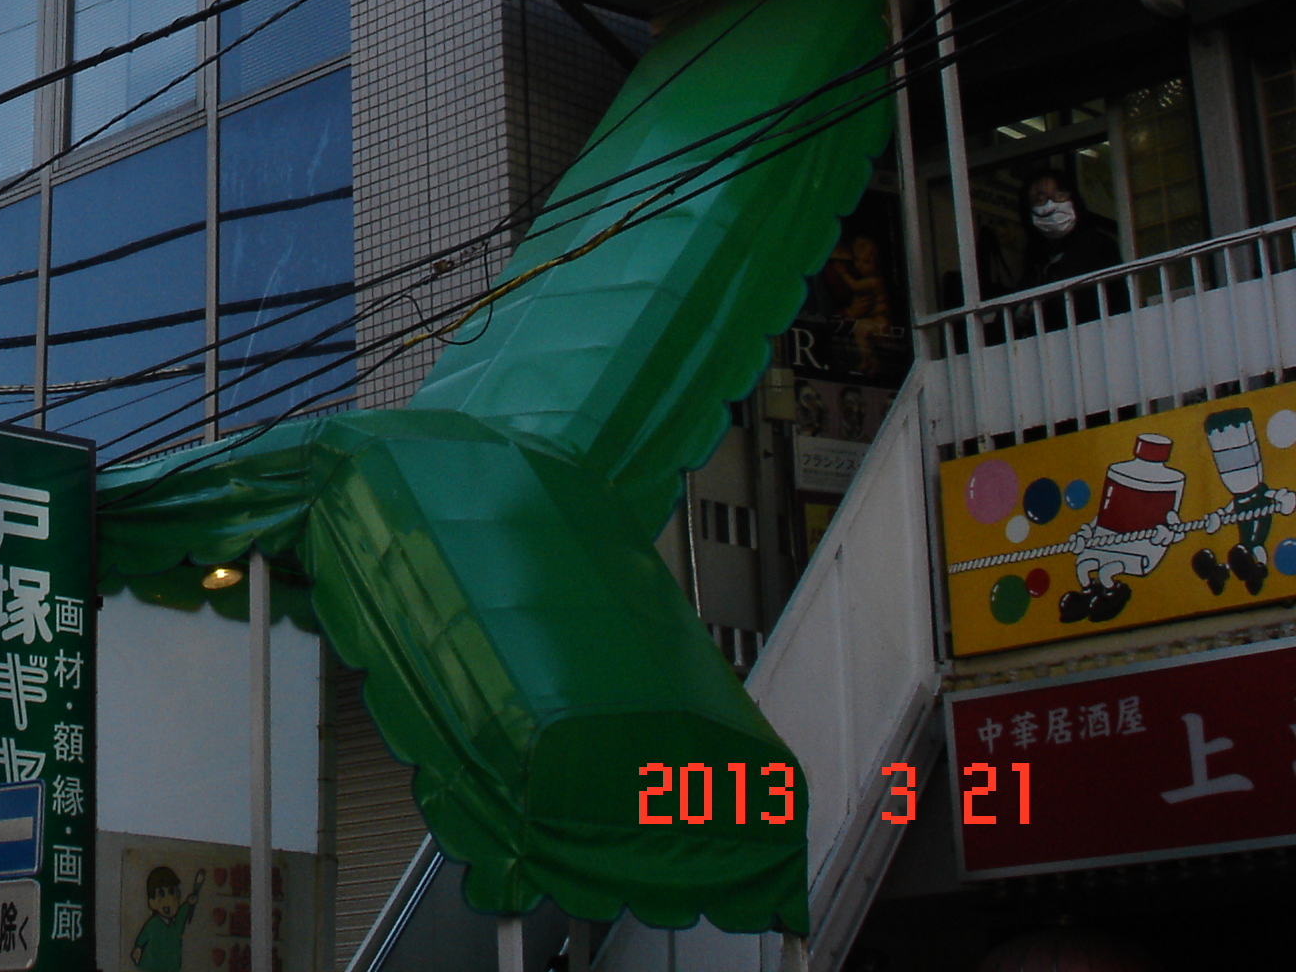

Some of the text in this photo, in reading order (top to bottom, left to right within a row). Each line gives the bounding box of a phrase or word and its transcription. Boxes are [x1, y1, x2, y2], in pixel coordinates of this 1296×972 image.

[51, 595, 85, 942] 画材・額縁・画廊
[976, 695, 1147, 755] 中華居酒屋
[1160, 697, 1296, 806] 上
